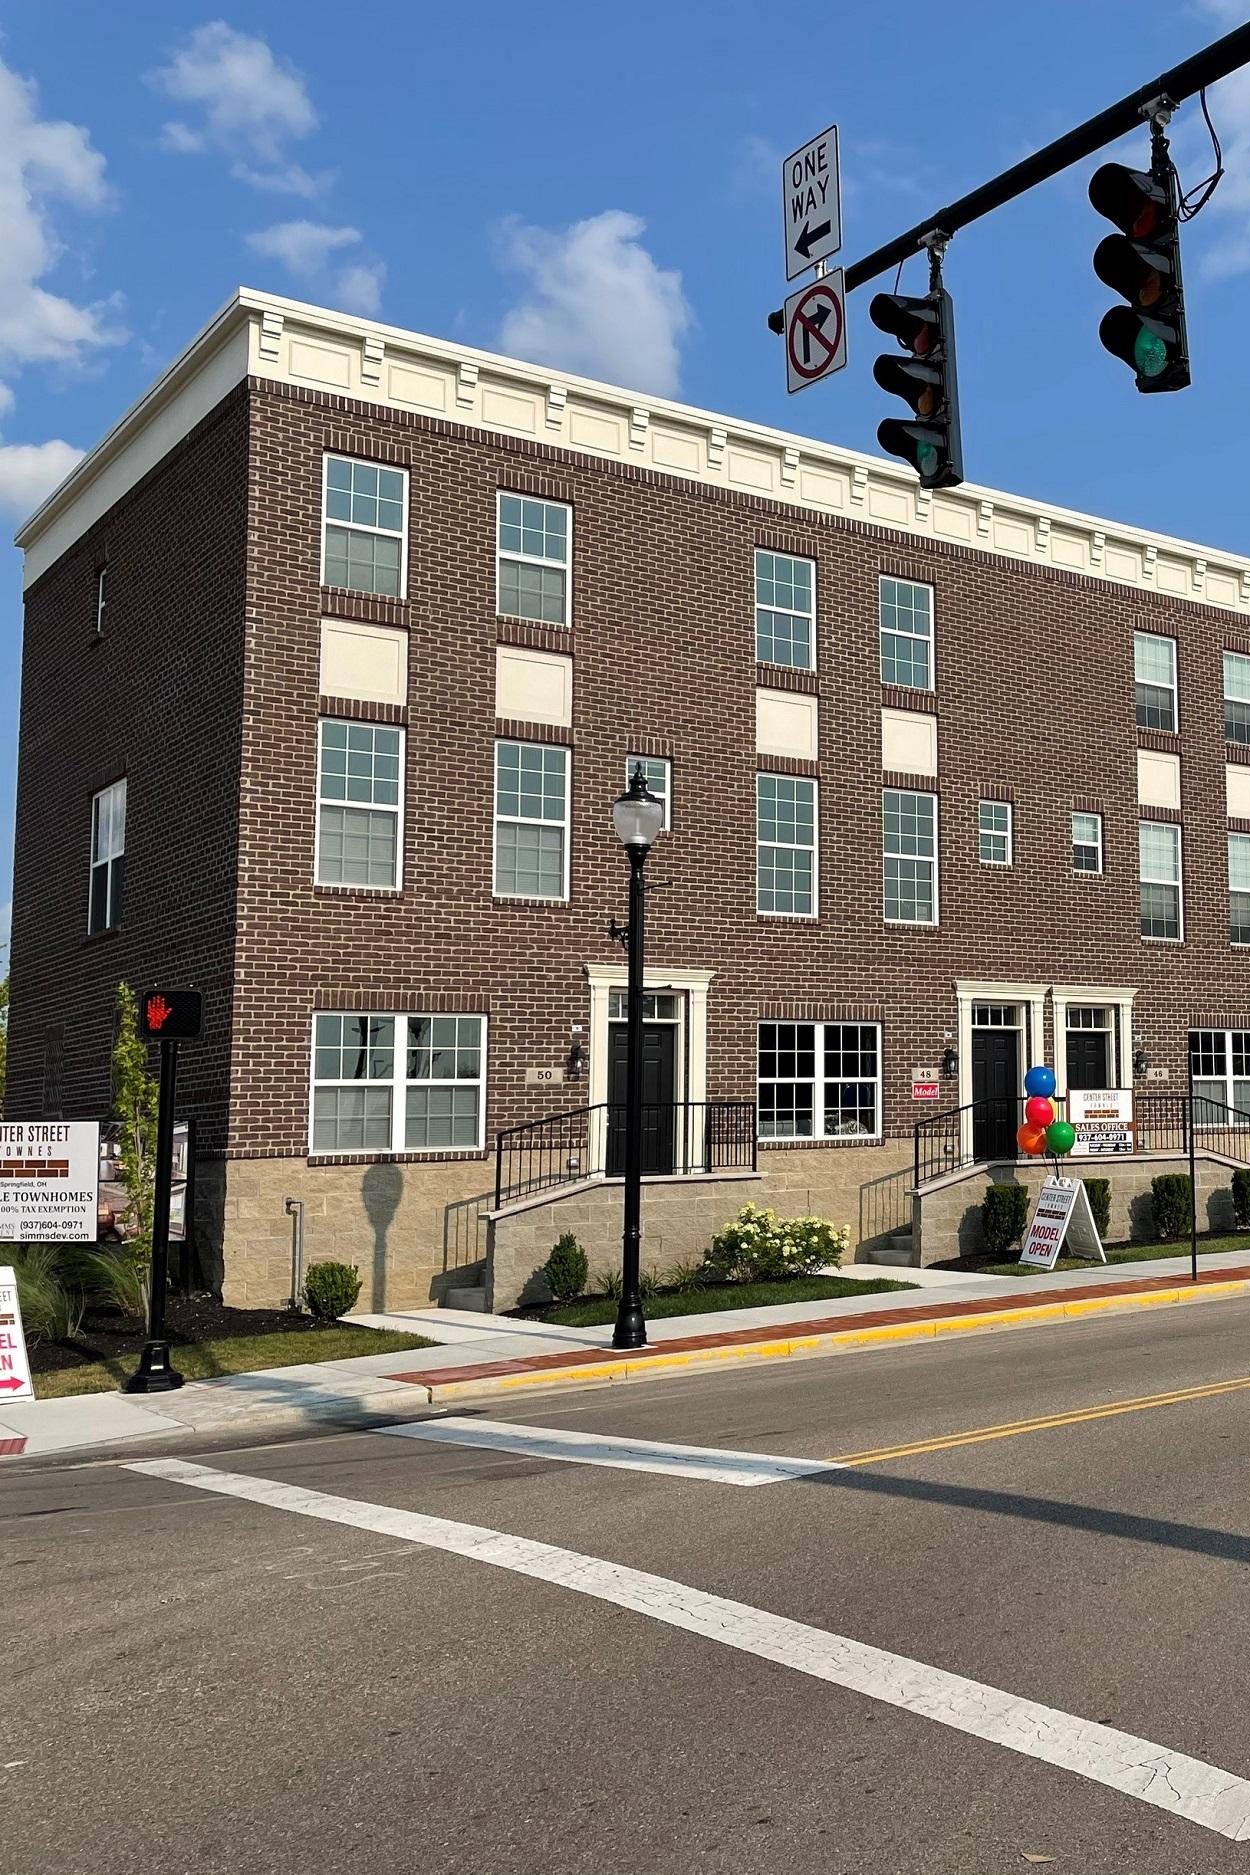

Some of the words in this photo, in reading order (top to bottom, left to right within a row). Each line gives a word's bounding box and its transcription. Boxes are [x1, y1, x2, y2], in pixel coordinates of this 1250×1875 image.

[792, 142, 828, 189] ONE
[791, 174, 830, 223] WAY
[537, 1070, 552, 1080] 50
[919, 1070, 932, 1079] 48
[1153, 1070, 1163, 1078] 46
[914, 1086, 938, 1096] Model
[1075, 1122, 1100, 1132] SALES
[1101, 1122, 1129, 1131] OFFICE
[28, 1125, 71, 1142] STREET
[1078, 1133, 1125, 1142] 937-604-0971
[0, 1145, 52, 1157] OWNES
[13, 1191, 94, 1202] TOWNHOMES
[21, 1205, 37, 1213] TAX
[38, 1205, 86, 1213] EXEMPTION
[20, 1220, 83, 1231] (937)604-0971
[20, 1231, 90, 1240] simmsdev.com
[1030, 1224, 1059, 1241] MODEL
[1028, 1241, 1053, 1257] OPEN
[0, 1354, 13, 1371] N
